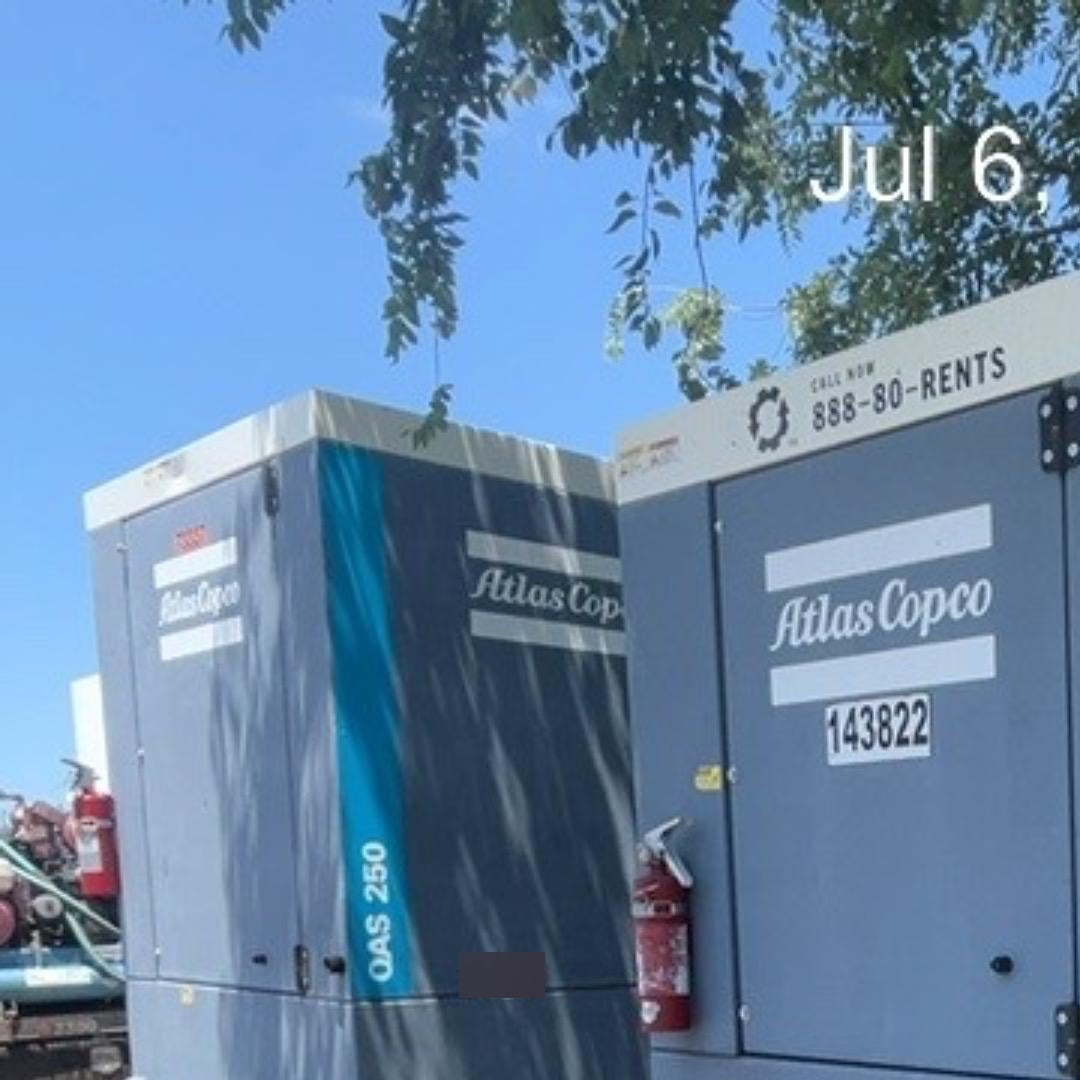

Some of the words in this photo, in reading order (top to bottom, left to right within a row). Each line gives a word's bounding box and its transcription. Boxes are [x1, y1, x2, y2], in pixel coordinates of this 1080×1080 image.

[811, 375, 842, 394] CALL
[849, 361, 876, 381] NOW
[812, 346, 1007, 432] 888-80-RENTS
[469, 567, 565, 611] Atlas
[769, 593, 874, 651] Atlas
[878, 578, 993, 638] Copco
[828, 699, 928, 754] 143822
[362, 841, 388, 904] 250
[365, 914, 394, 982] QAS
